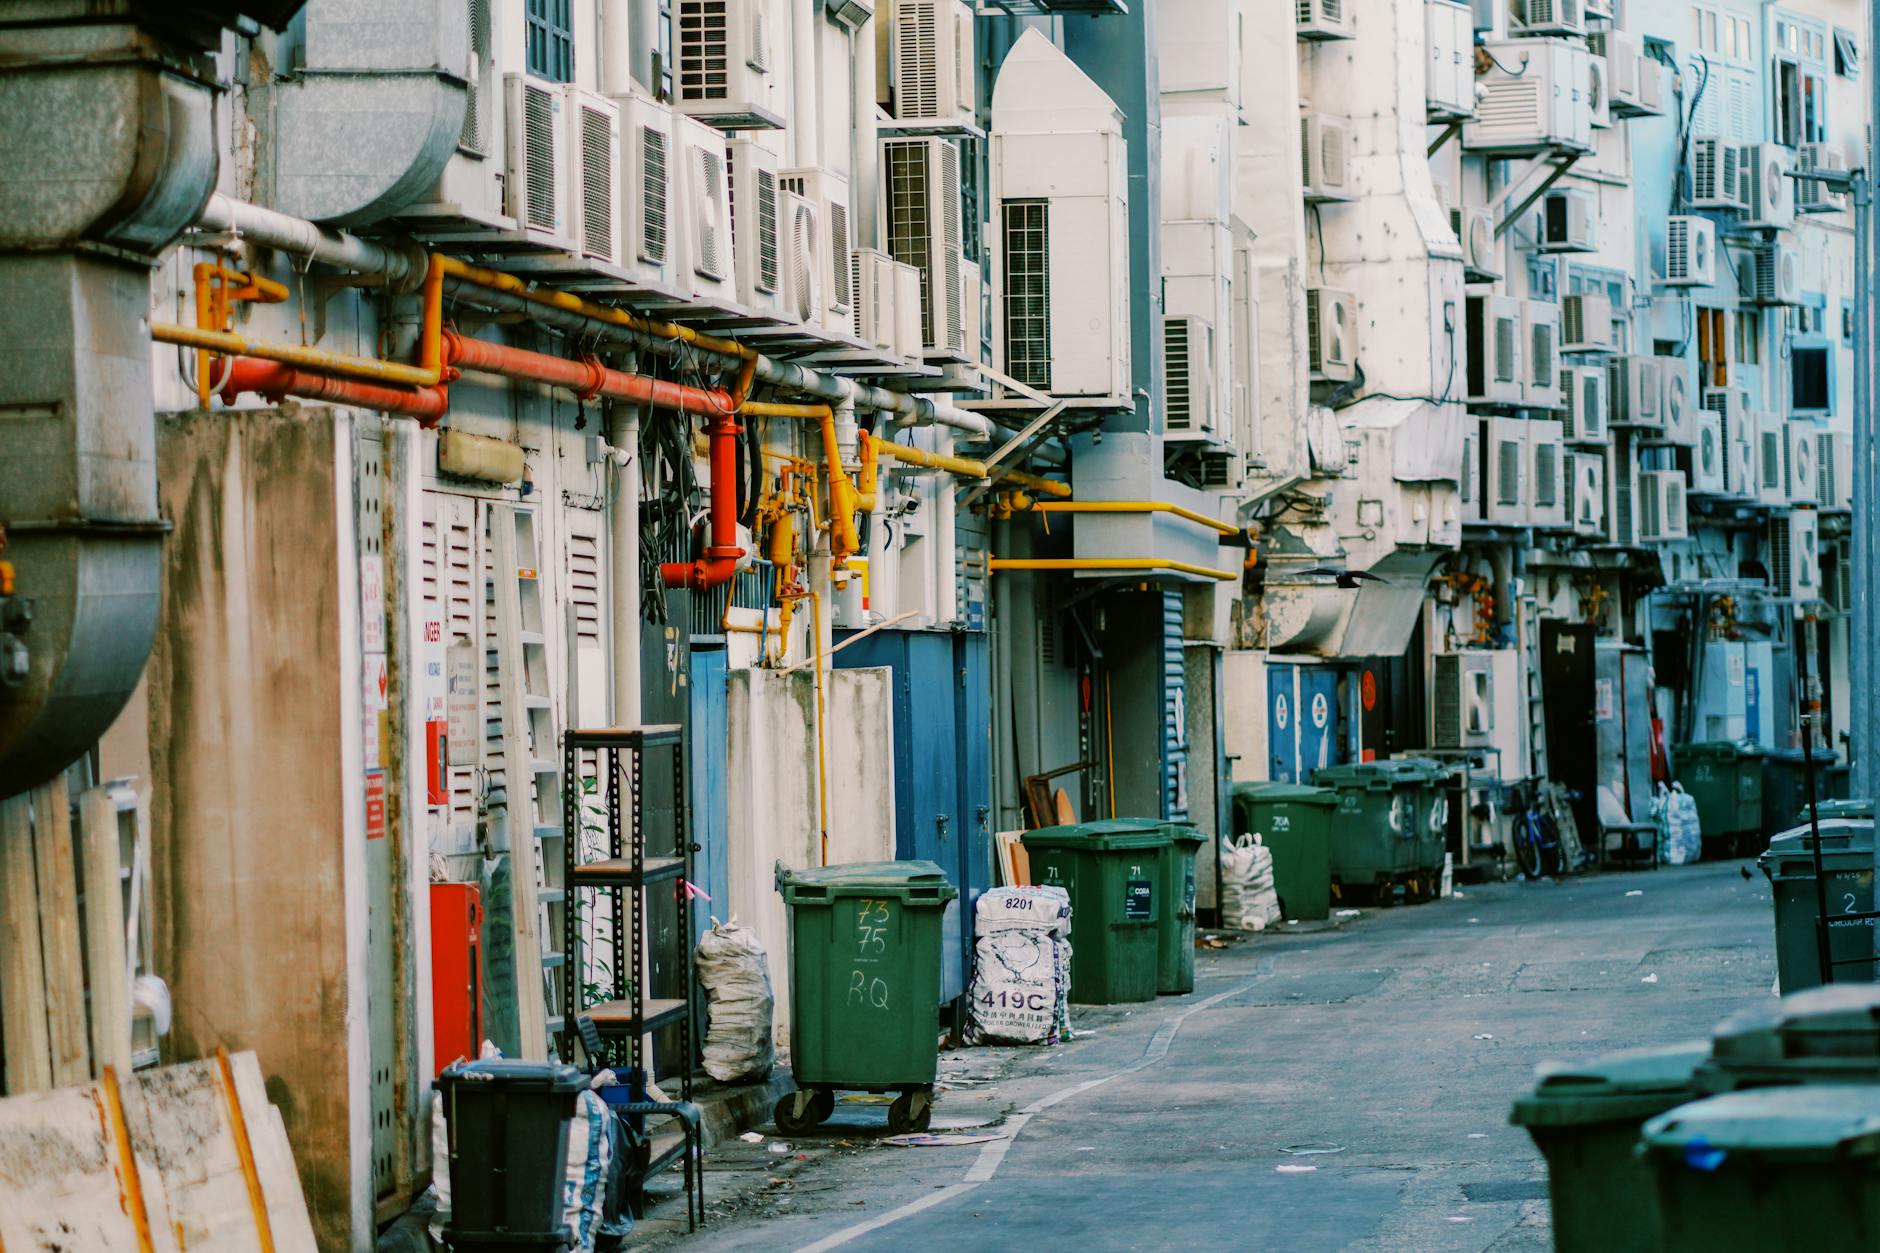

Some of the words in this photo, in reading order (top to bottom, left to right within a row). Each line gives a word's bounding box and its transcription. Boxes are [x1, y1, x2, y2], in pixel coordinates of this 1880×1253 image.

[1272, 815, 1290, 826] 70A
[1047, 866, 1059, 878] 71
[1130, 865, 1141, 876] 71
[1005, 897, 1033, 911] 8201
[1843, 892, 1857, 914] 2
[858, 899, 890, 925] 73
[858, 926, 888, 953] 75
[981, 990, 1044, 1011] 419C
